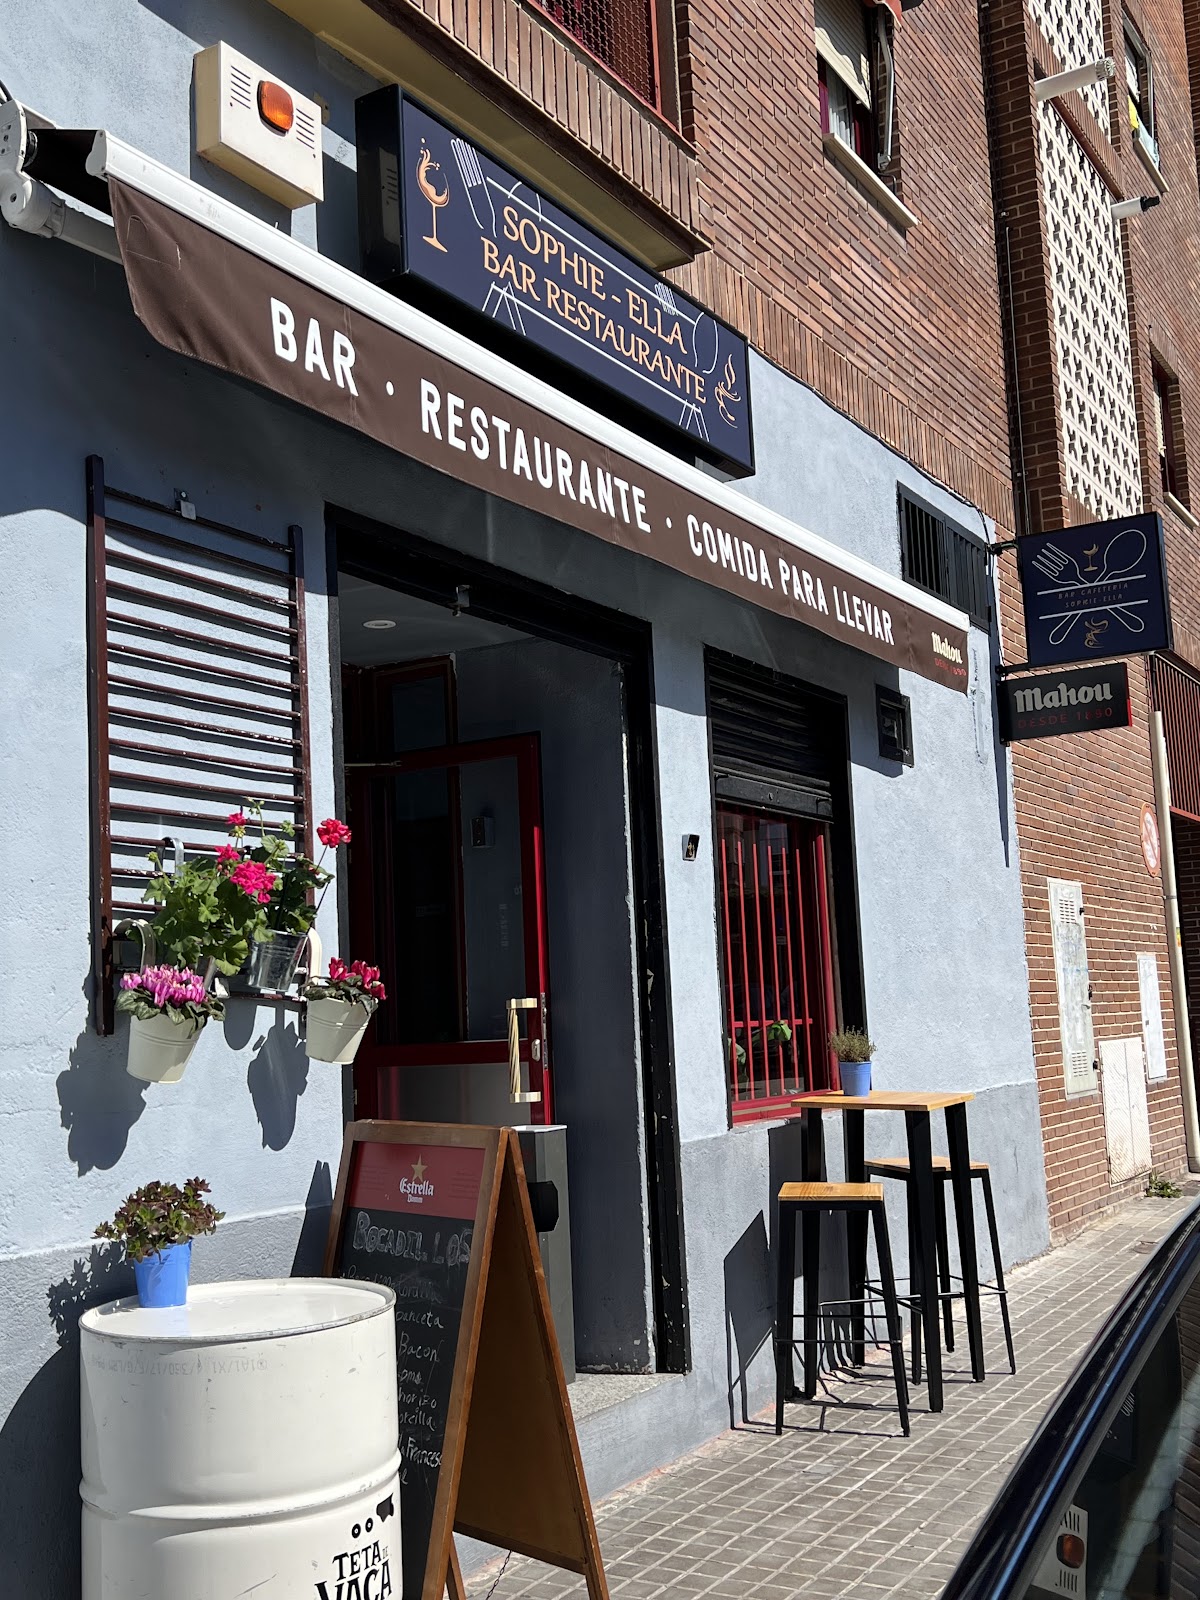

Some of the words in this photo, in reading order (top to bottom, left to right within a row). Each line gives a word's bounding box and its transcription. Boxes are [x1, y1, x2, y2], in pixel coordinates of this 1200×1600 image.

[503, 205, 606, 301] SOPHIE
[626, 288, 687, 354] ELLA
[481, 237, 540, 301] BAR
[544, 277, 707, 404] RESTAURANTE
[270, 297, 359, 397] BAR
[420, 378, 652, 534] RESTAURANTE
[686, 514, 774, 590] COMIDA
[778, 557, 829, 615] PARA
[833, 585, 895, 646] LLEVAR
[1017, 714, 1068, 729] DESDE
[399, 1177, 435, 1197] Estrella
[398, 1331, 440, 1363] Bacon
[398, 1387, 437, 1409] horizo
[399, 1407, 435, 1432] orcilla
[332, 1539, 382, 1582] TETA
